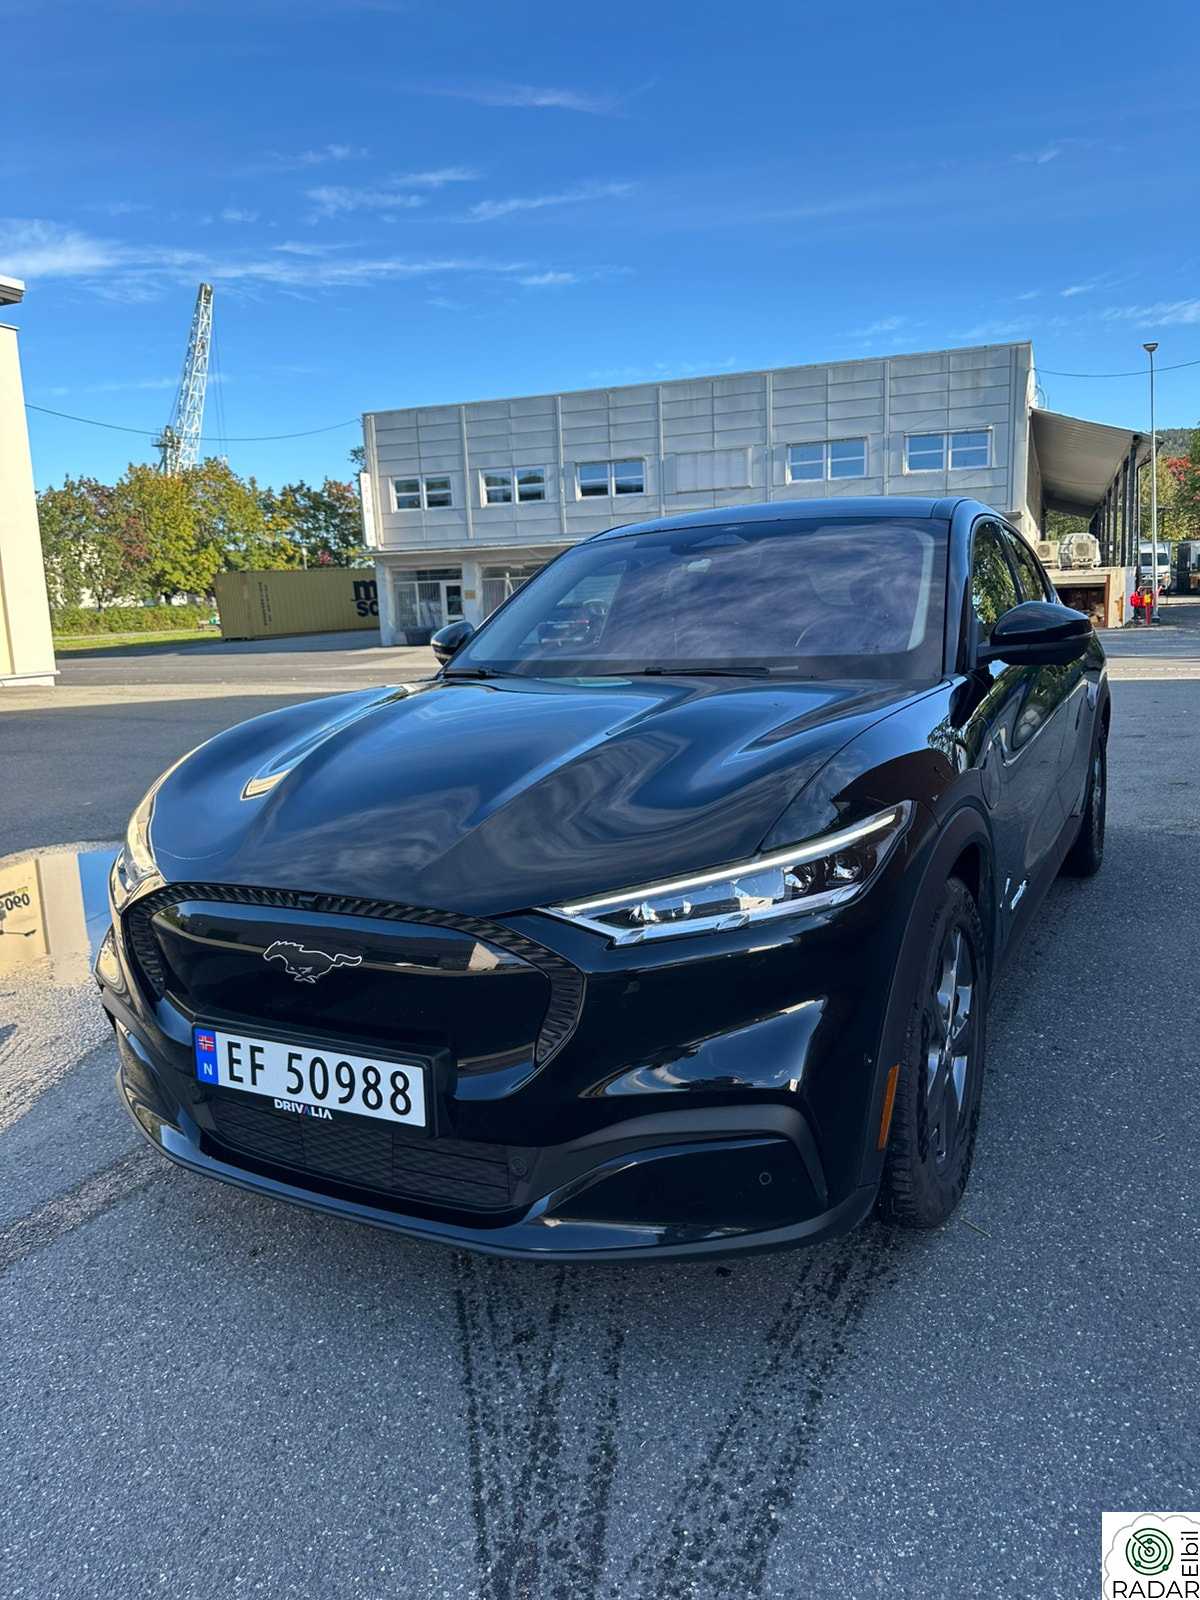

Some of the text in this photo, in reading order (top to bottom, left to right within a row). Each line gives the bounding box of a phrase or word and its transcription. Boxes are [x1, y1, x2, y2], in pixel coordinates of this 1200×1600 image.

[203, 1062, 213, 1076] N
[227, 1040, 412, 1116] EF 50988
[274, 1098, 333, 1120] DRIVALIA
